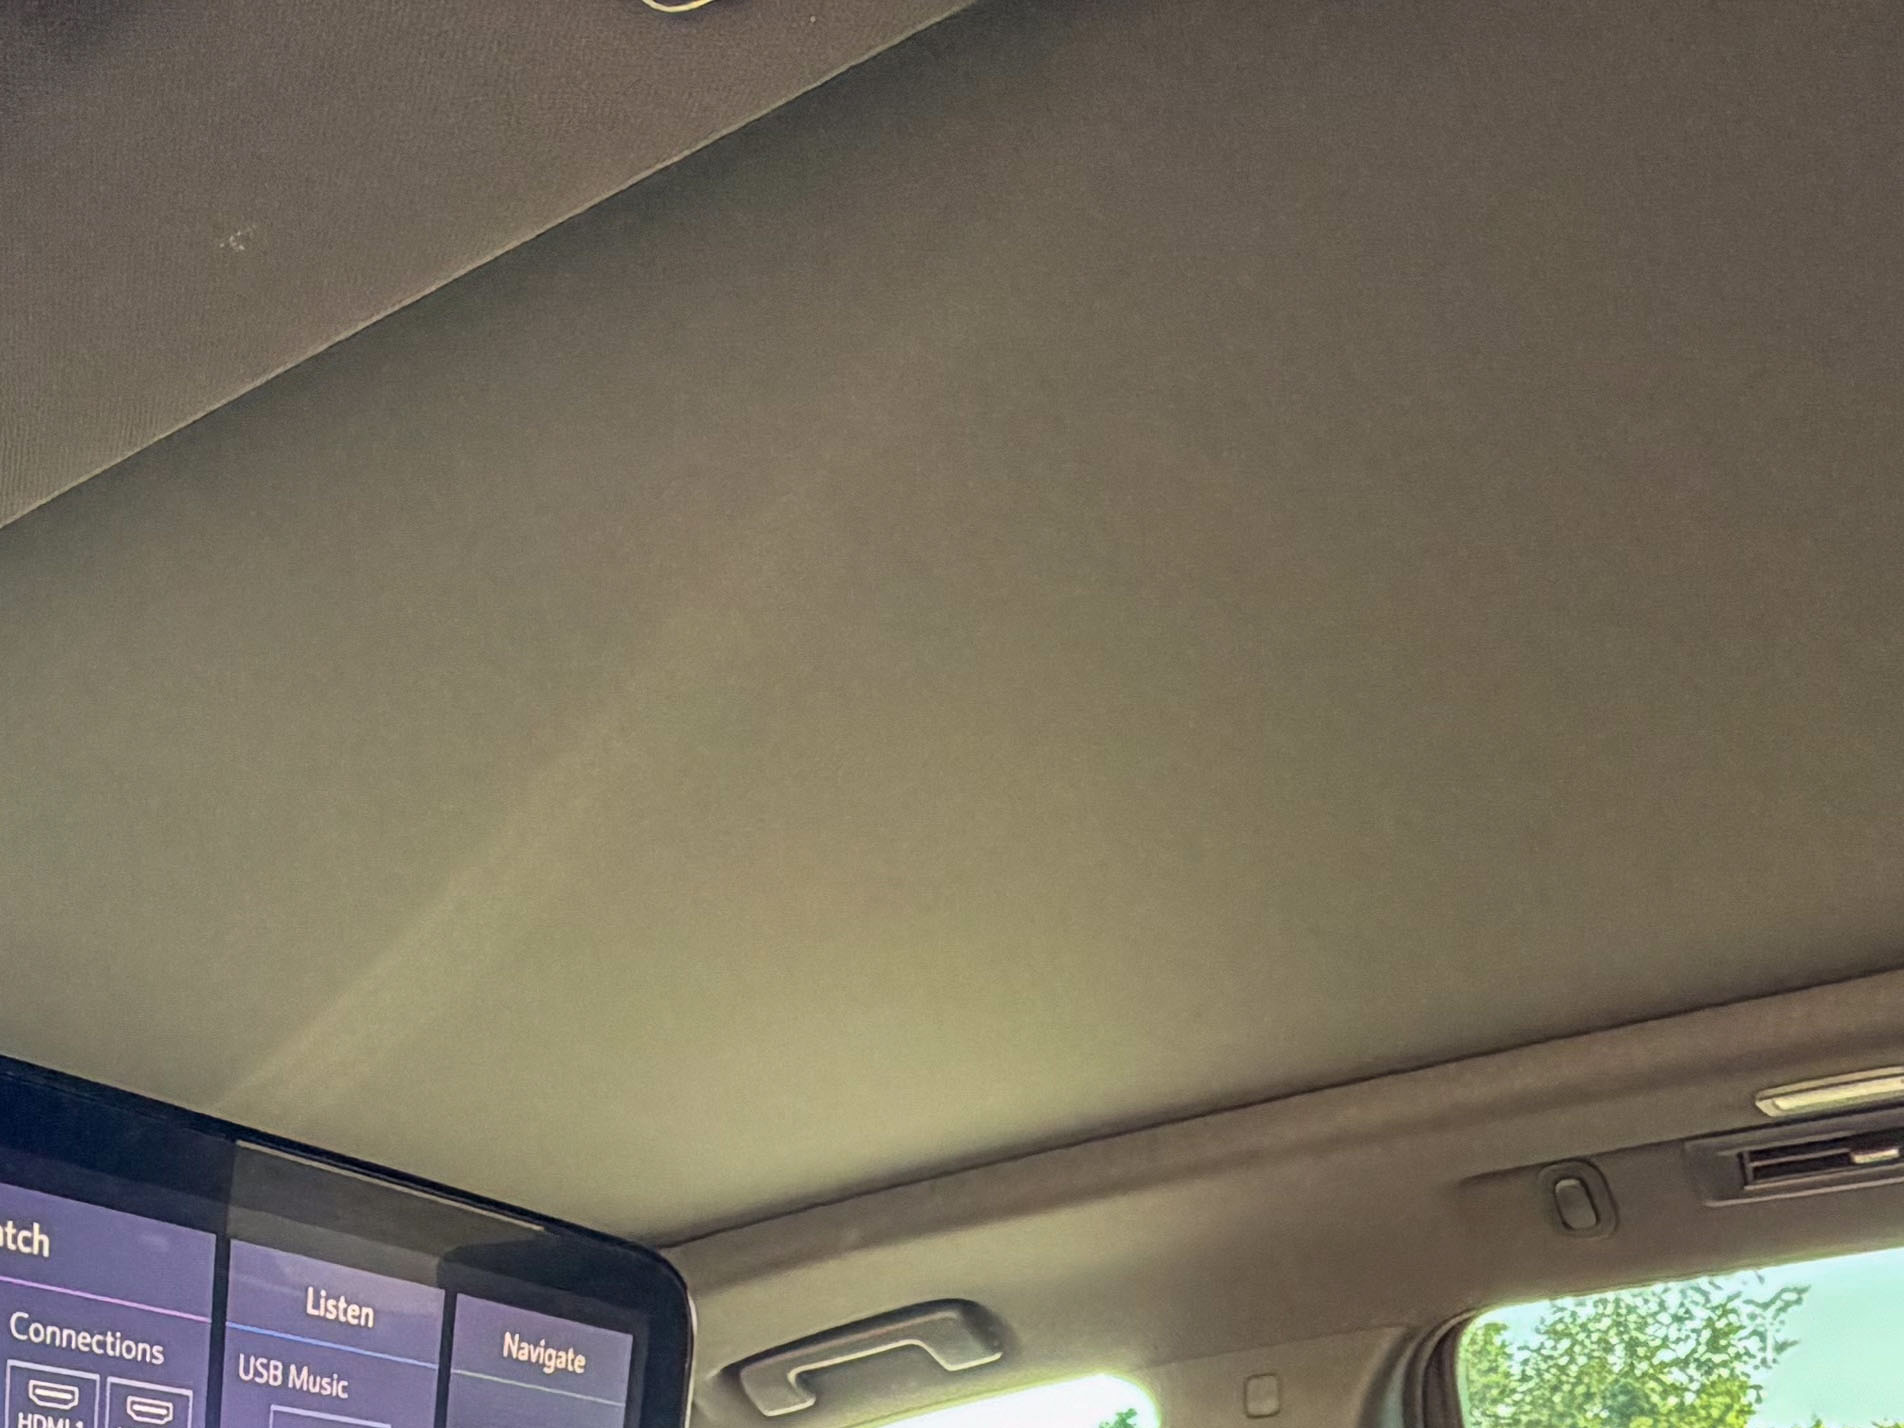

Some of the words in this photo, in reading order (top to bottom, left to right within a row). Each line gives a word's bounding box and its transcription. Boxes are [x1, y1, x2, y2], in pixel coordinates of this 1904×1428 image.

[306, 1286, 374, 1328] Listen
[10, 1312, 164, 1365] Connections
[503, 1331, 586, 1374] Navigate
[238, 1353, 283, 1386] USB
[288, 1364, 349, 1399] Music
